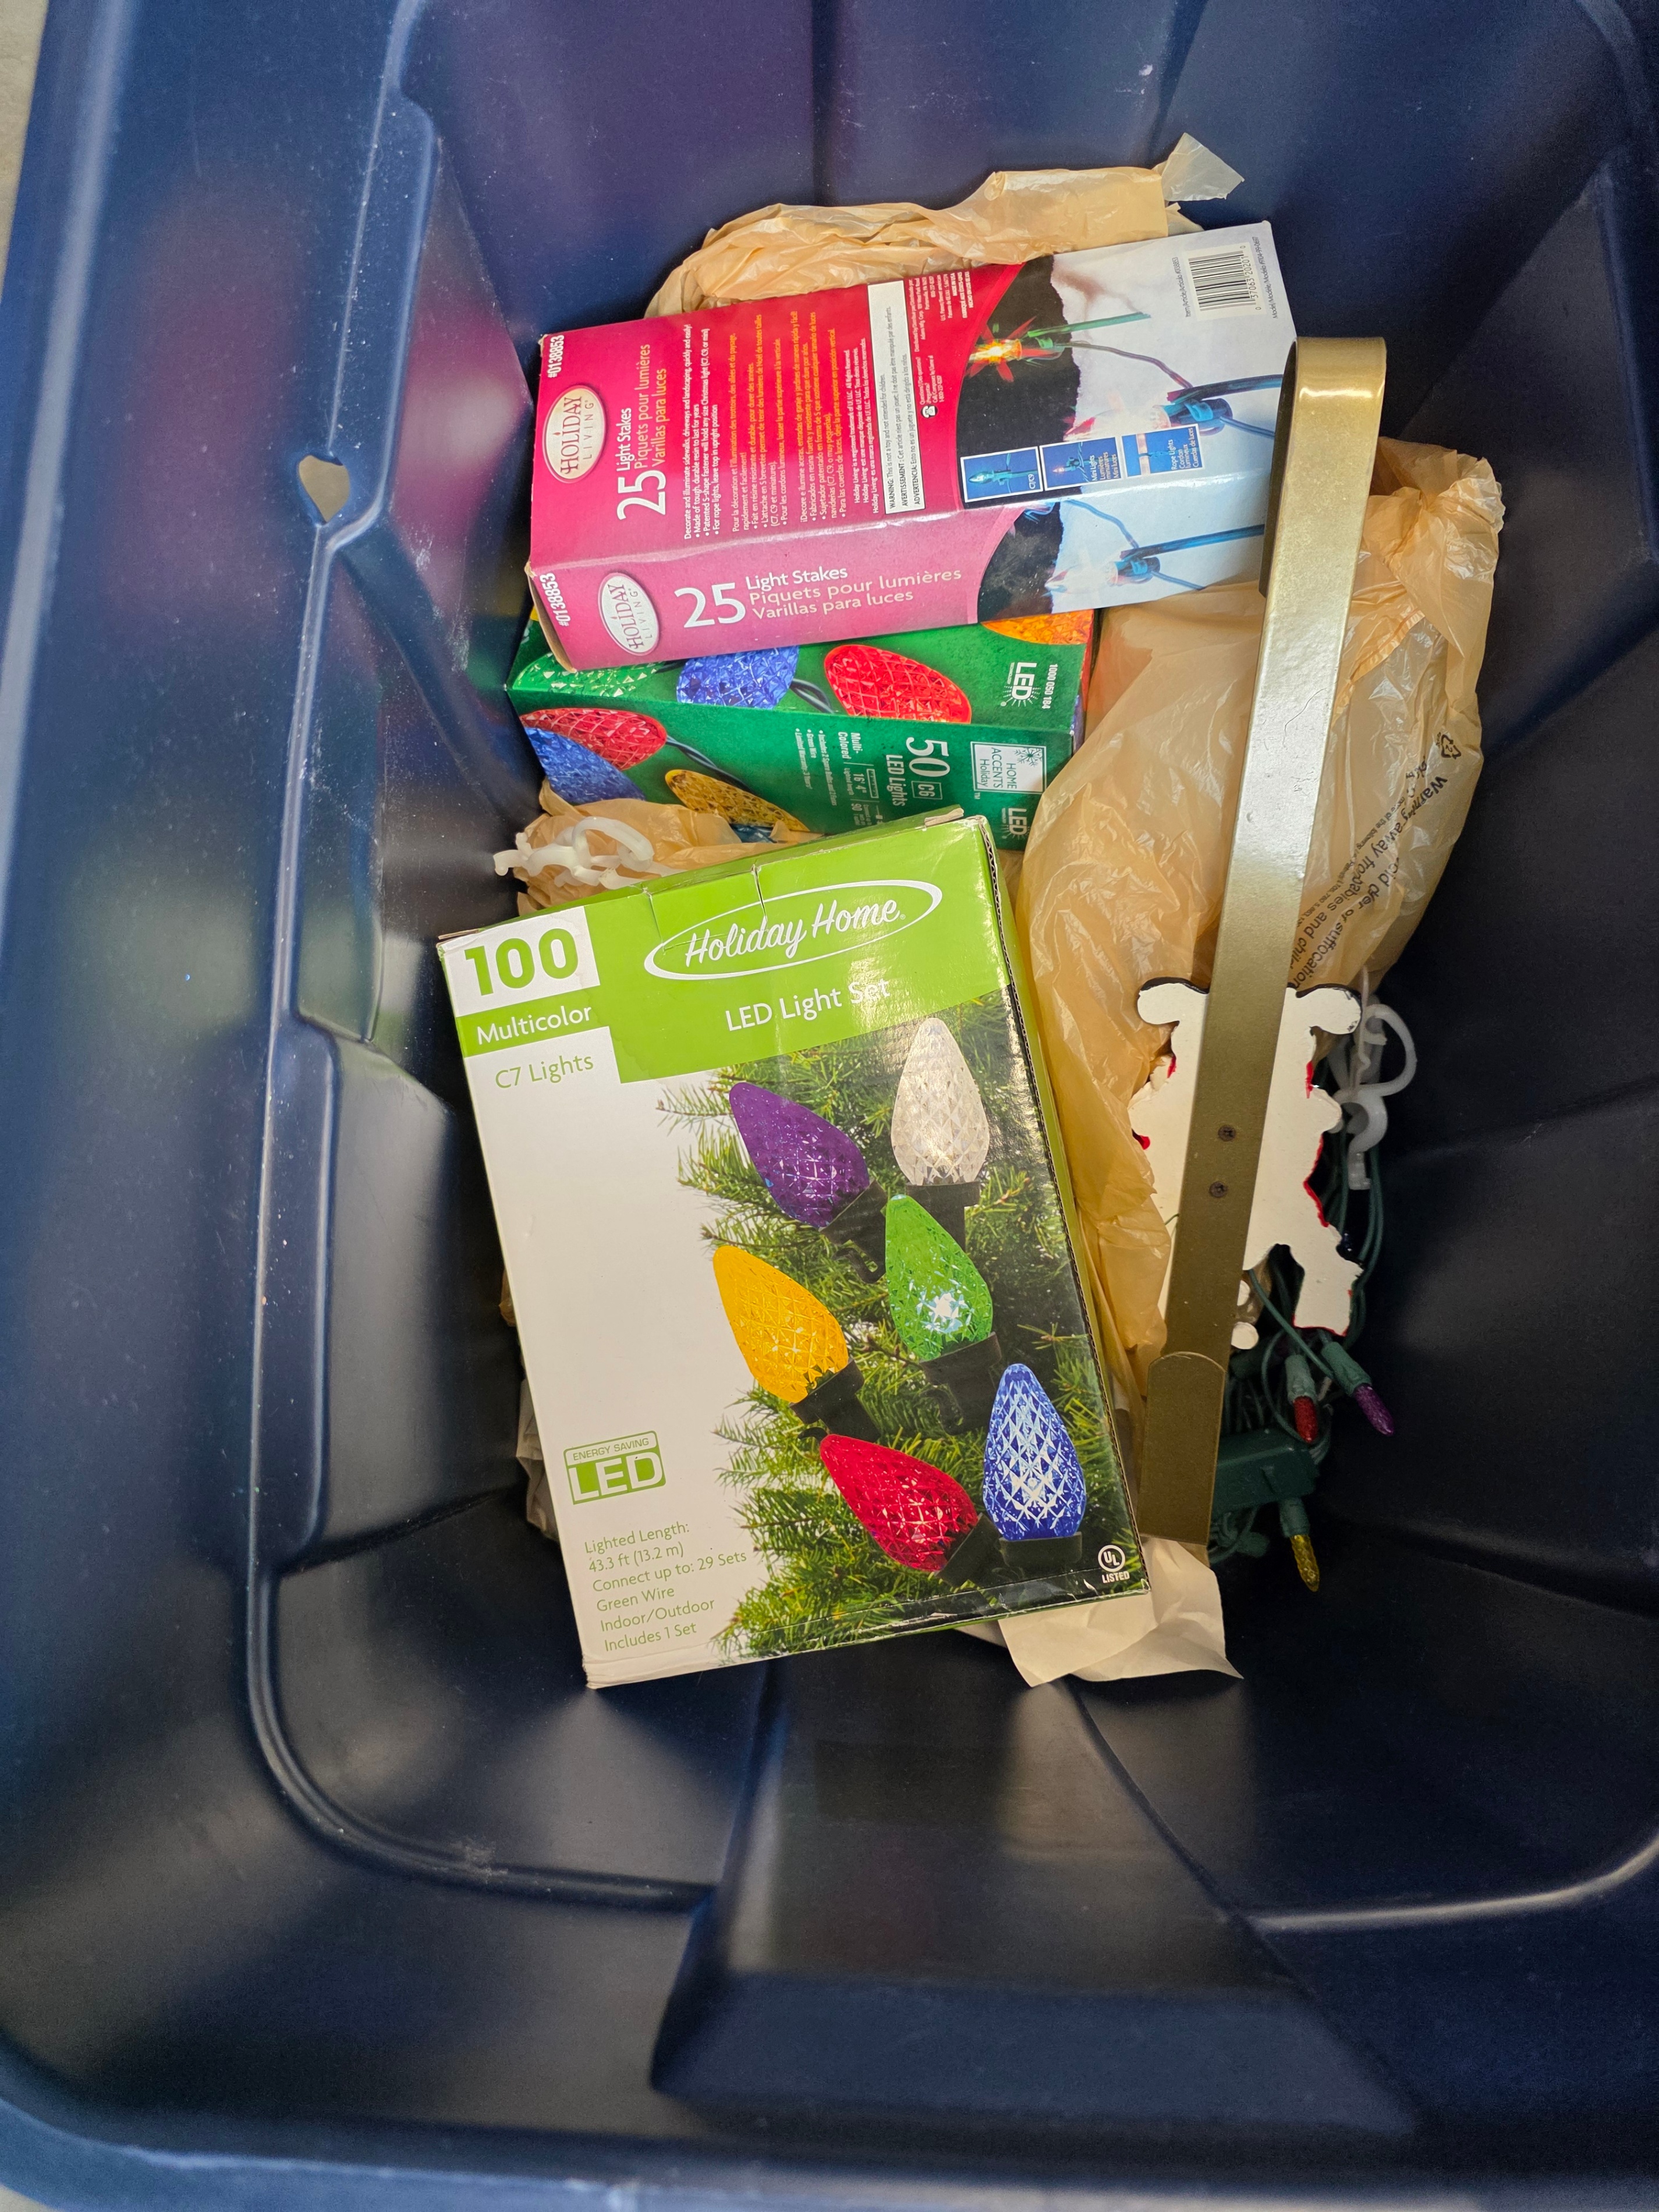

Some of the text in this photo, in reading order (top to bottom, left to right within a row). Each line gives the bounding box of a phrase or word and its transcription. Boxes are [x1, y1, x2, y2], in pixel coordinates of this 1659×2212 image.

[1242, 256, 1253, 275] 20201
[1246, 278, 1259, 299] 37063
[547, 335, 564, 378] #0138853
[634, 344, 652, 469] Piquets pour lumières
[651, 368, 669, 467] Varillas para luces
[711, 405, 719, 427] position
[560, 396, 582, 474] HOLIDAY
[616, 407, 634, 471] Light Stakes
[711, 428, 719, 448] upright
[1168, 439, 1176, 455] Lights
[1089, 455, 1097, 470] Lights
[1183, 444, 1192, 469] lumineux
[1190, 447, 1200, 468] Cuerdas
[616, 470, 665, 520] 25
[693, 484, 701, 505] tough,
[702, 477, 710, 502] S-shape
[711, 484, 720, 502] lights,
[887, 478, 895, 509] WARNING:
[898, 463, 908, 506] AVERTISSEMENT
[911, 465, 920, 504] ADVERTENCIA:
[1028, 474, 1037, 490] C7/C9
[693, 514, 701, 533] Made
[702, 502, 710, 531] Patented
[746, 566, 848, 591] Light Stakes
[749, 569, 962, 605] Piquets pour lumières
[540, 573, 571, 626] #0138853
[674, 582, 746, 628] 25
[752, 591, 914, 619] Varillas para luces
[608, 584, 644, 649] HOLIDAY
[1012, 662, 1037, 700] LED
[1041, 664, 1058, 709] 1000 050 184
[795, 732, 804, 750] Limited
[818, 735, 828, 753] Includes
[838, 732, 851, 759] Colored
[851, 732, 863, 753] Multi-
[886, 754, 908, 806] LED Lights
[906, 737, 950, 796] 50 C6
[977, 758, 990, 787] Holiday
[991, 747, 1002, 788] ACCENTS
[1005, 763, 1016, 789] HOME
[1008, 808, 1027, 835] LED
[1370, 823, 1406, 858] away
[686, 899, 900, 967] Holiday Home
[1304, 912, 1327, 940] and
[464, 928, 578, 996] 100
[1295, 925, 1343, 988] suffocation
[725, 979, 891, 1031] LED Light Set
[477, 1006, 591, 1045] Multicolor
[495, 1055, 594, 1089] C7 Lights
[573, 1438, 649, 1461] ENERGY SAVING
[569, 1452, 662, 1501] LED
[585, 1521, 690, 1554] Lighted Length:
[589, 1542, 684, 1572] 43.3 ft (13.2 m)
[593, 1550, 747, 1592] Connect up to: 29 Sets
[1103, 1551, 1119, 1566] UL
[1102, 1571, 1130, 1583] LISTED
[597, 1587, 675, 1612] Green Wire
[601, 1598, 715, 1632] Indoor/Outdoor
[605, 1623, 697, 1651] Includes 1 Set
